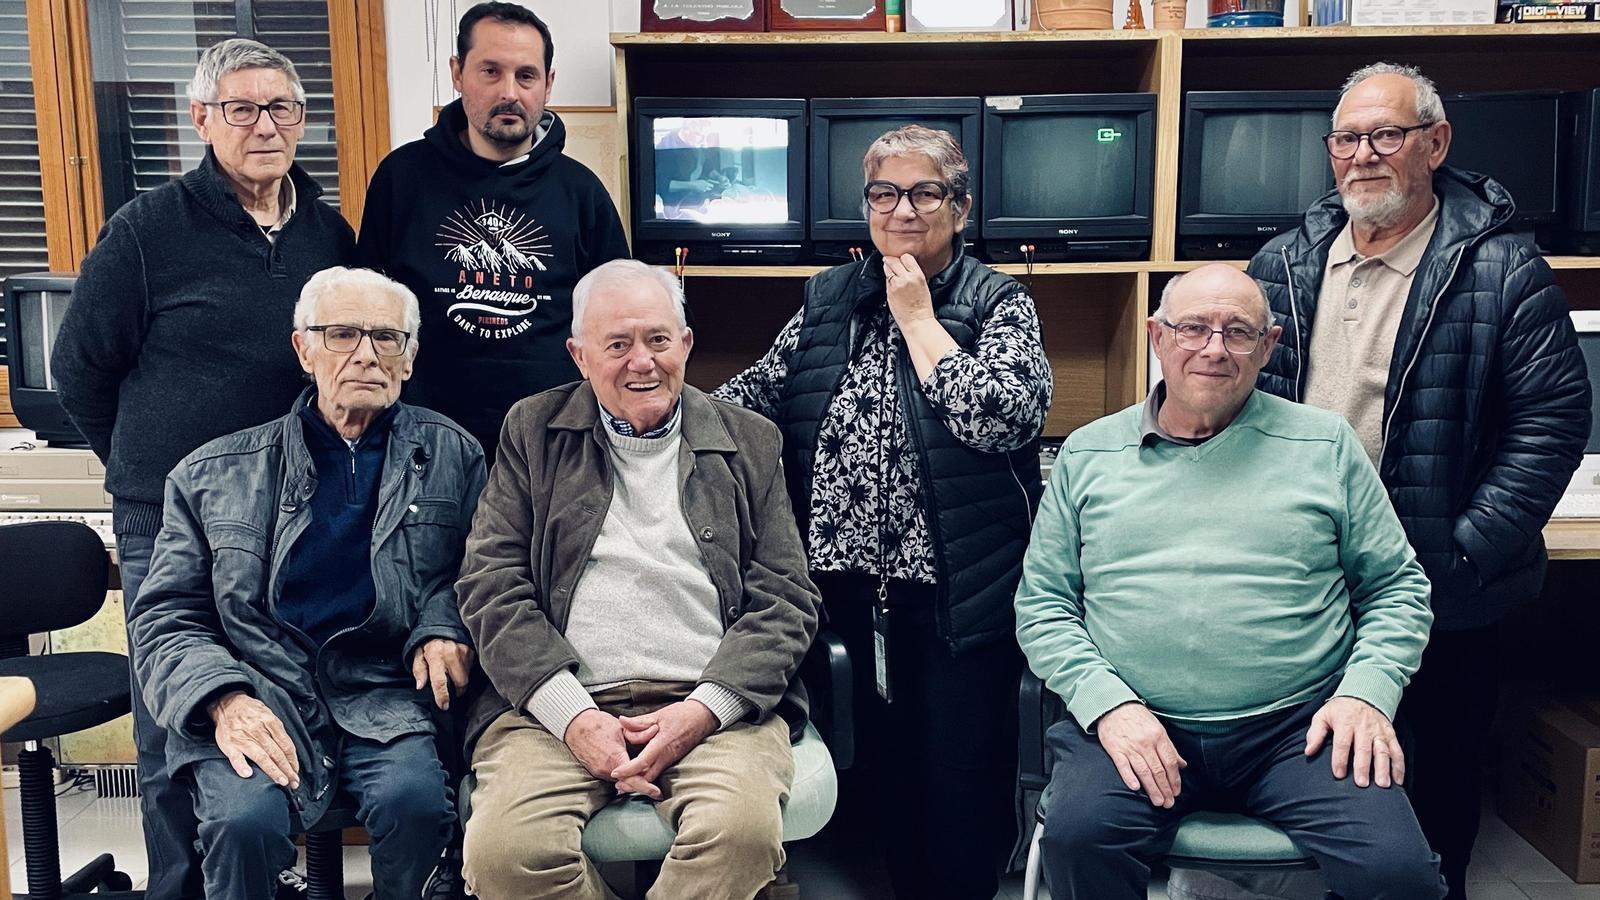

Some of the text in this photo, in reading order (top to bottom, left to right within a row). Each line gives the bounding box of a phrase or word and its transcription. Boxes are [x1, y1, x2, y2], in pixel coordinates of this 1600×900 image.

[482, 216, 504, 228] 3404
[458, 269, 533, 289] ANETO
[455, 284, 531, 307] Benasque
[453, 314, 533, 339] DARE TO EXPLORE
